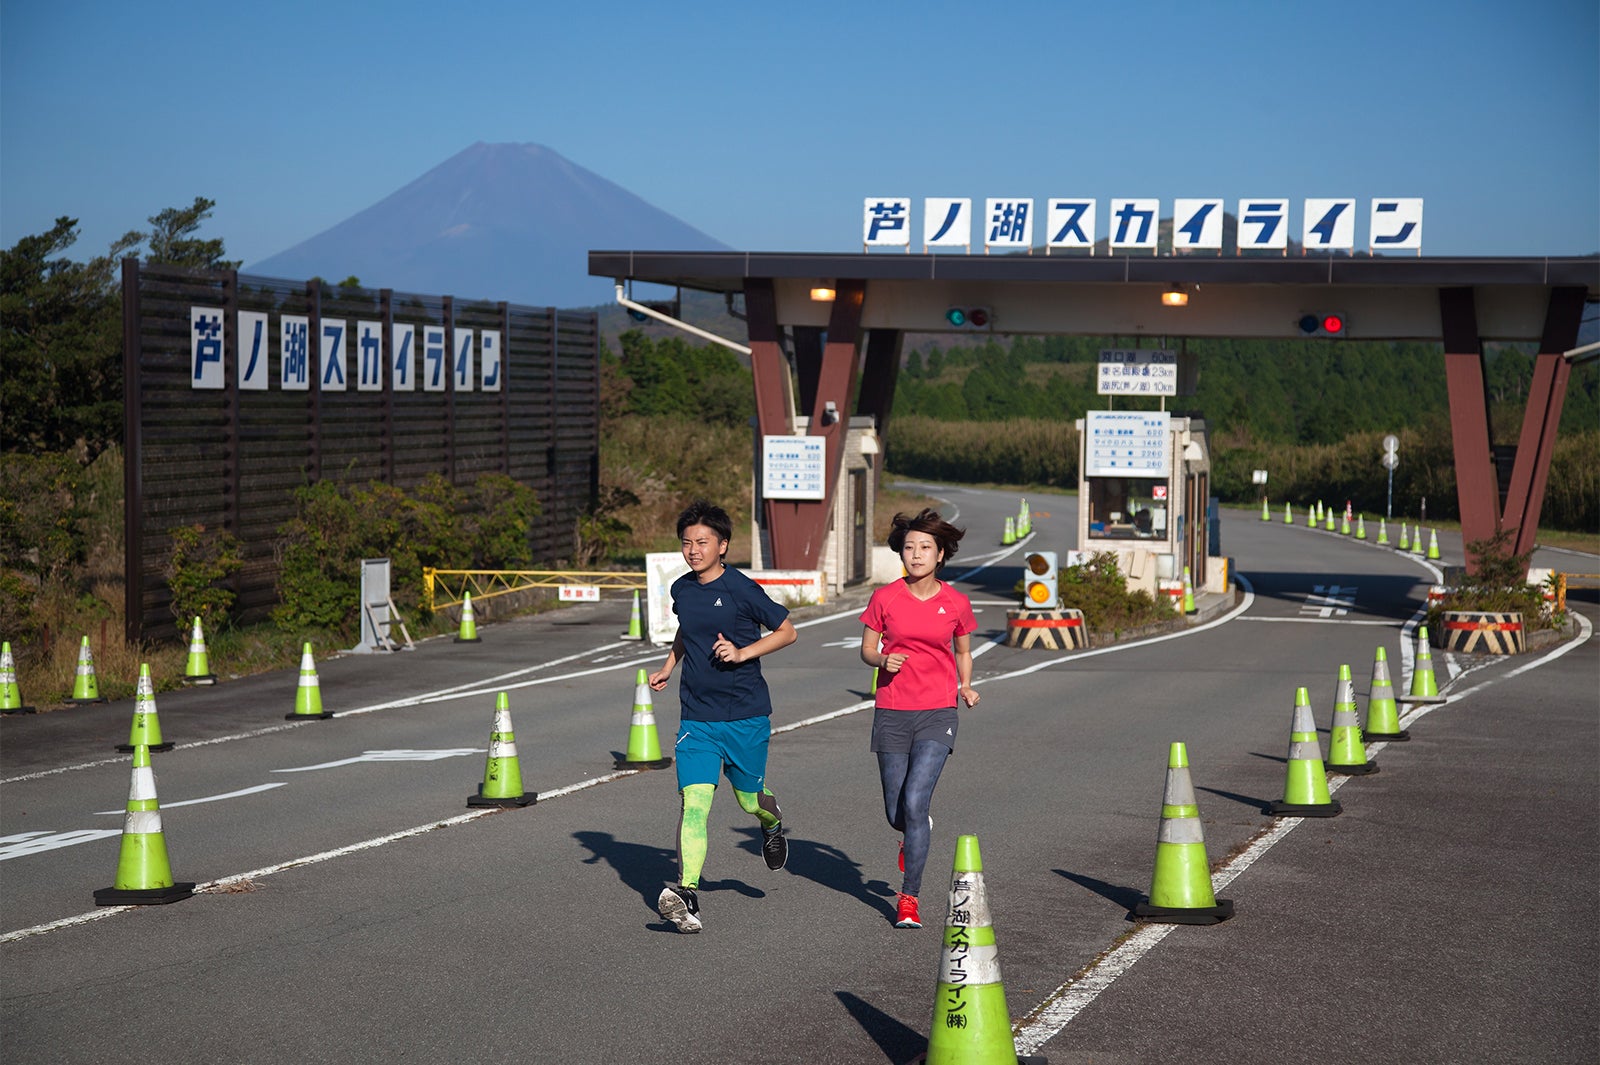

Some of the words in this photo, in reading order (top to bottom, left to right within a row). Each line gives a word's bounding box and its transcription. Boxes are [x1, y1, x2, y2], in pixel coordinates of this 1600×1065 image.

[867, 203, 1417, 244] 芦ノ湖スカイライン
[194, 314, 500, 386] 芦ノ湖スカイライン
[1153, 381, 1175, 392] 10km
